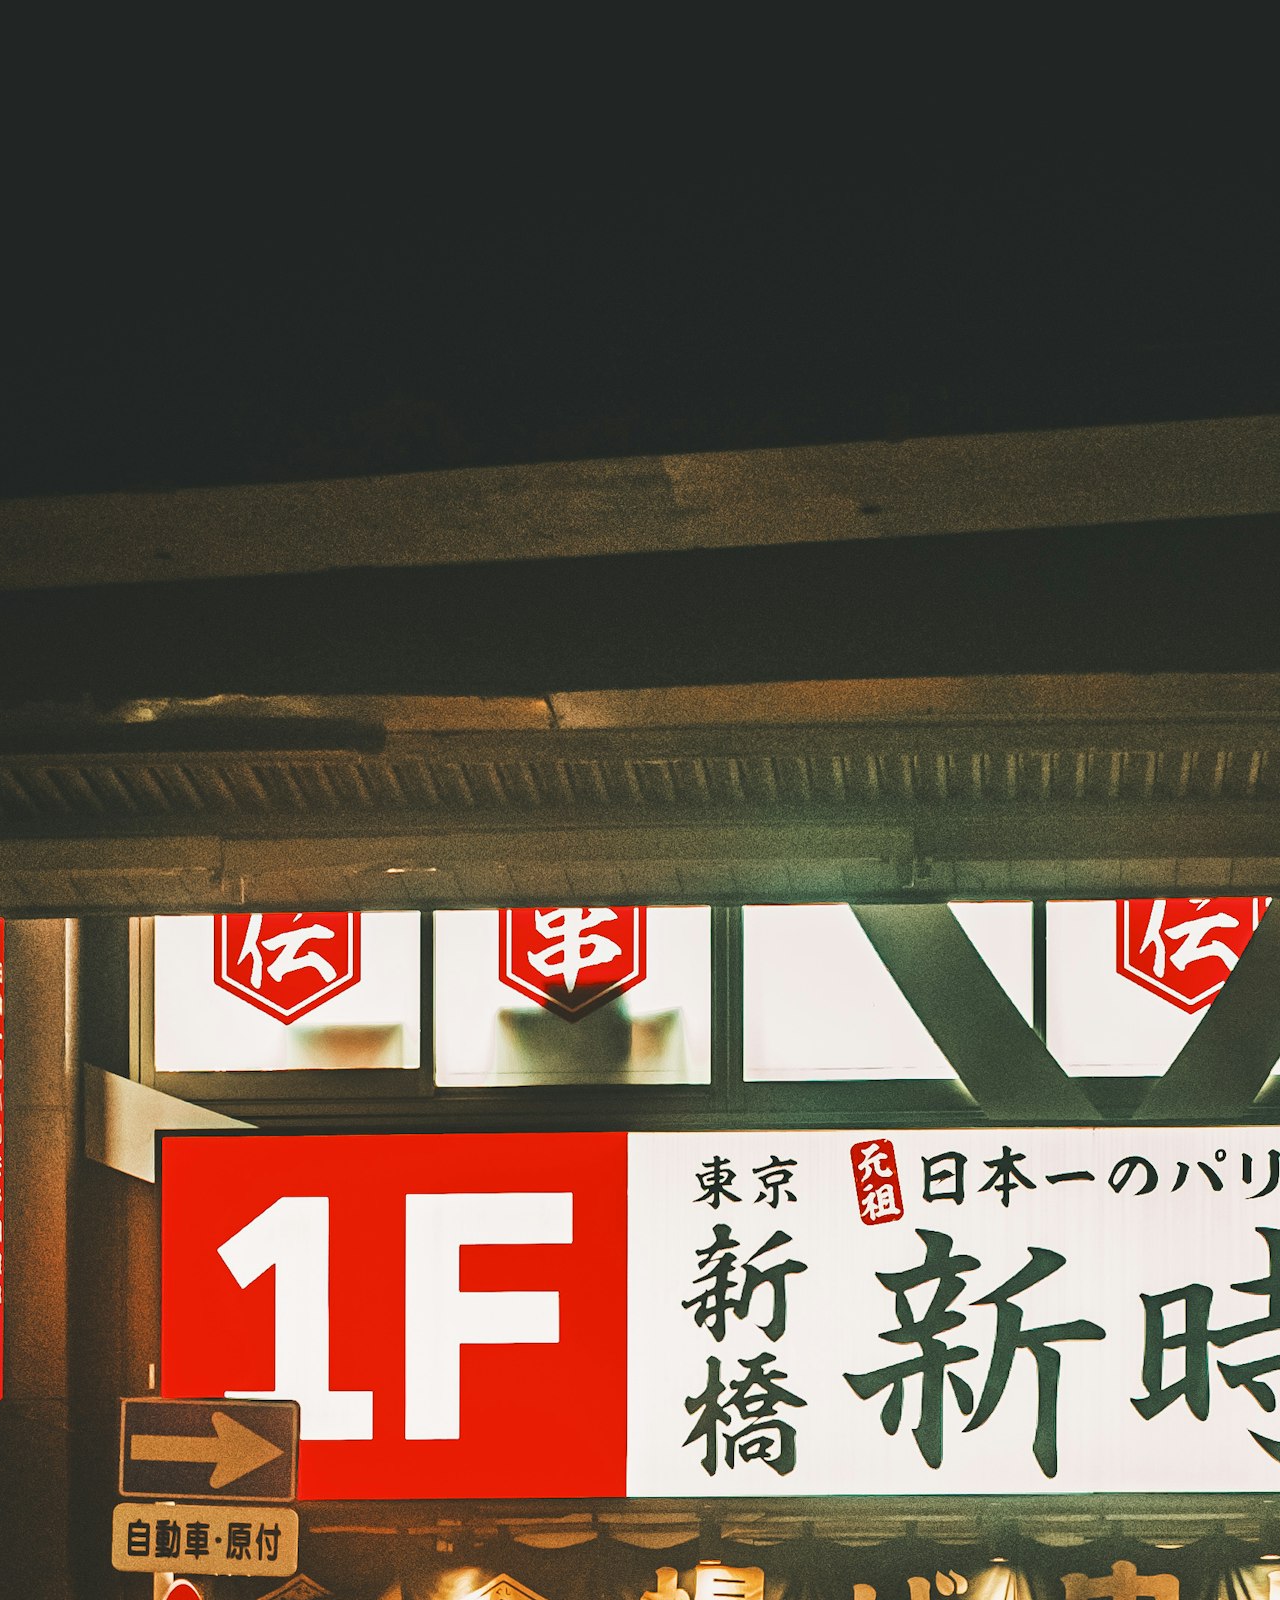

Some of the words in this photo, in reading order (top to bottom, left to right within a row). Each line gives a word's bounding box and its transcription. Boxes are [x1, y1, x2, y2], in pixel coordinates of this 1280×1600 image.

[693, 1154, 799, 1208] 東京
[856, 1141, 903, 1223] 元祖
[217, 1191, 573, 1440] 1F
[682, 1223, 808, 1478] 新橋
[127, 1519, 282, 1562] 自動車・原付
